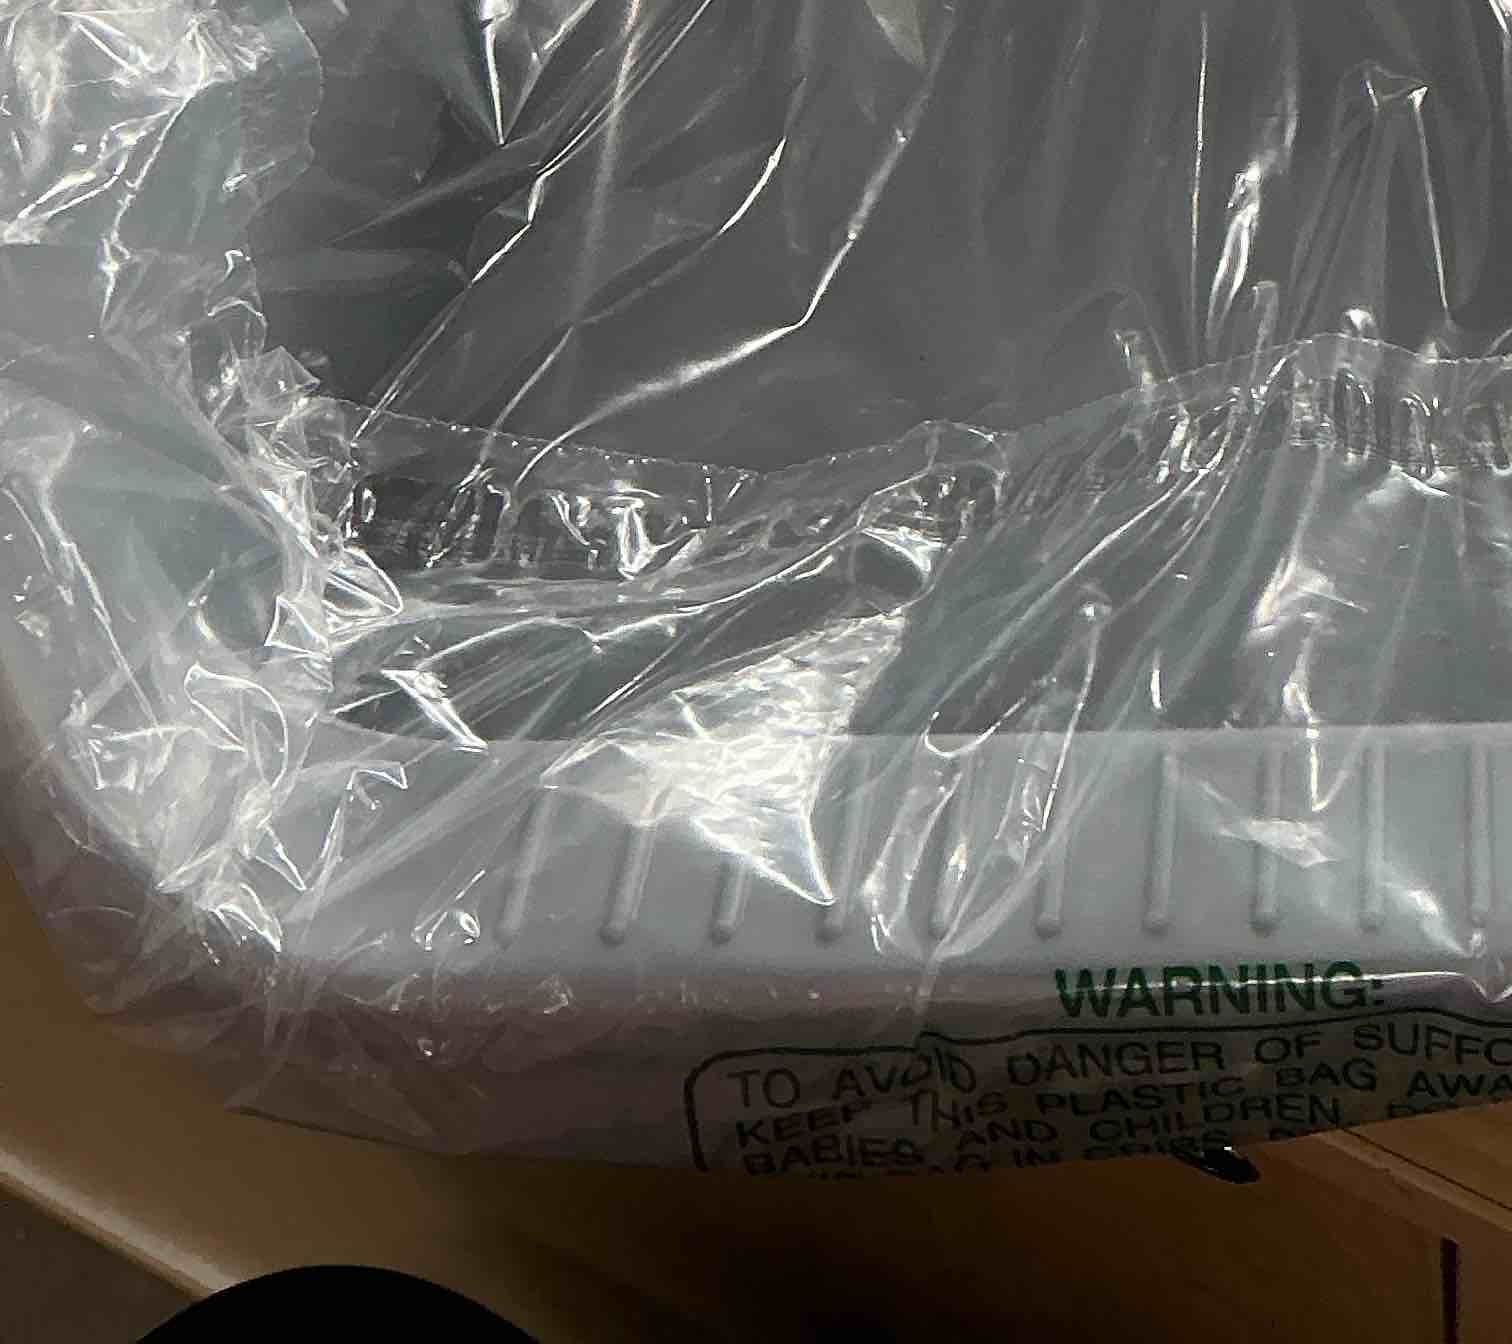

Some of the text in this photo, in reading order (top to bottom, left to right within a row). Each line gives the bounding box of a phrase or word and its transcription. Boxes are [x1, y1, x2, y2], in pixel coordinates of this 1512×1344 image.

[1055, 961, 1384, 1018] WARNING:
[727, 1068, 802, 1109] TO
[832, 1046, 977, 1102] AVOID
[1007, 1040, 1225, 1087] DANGER
[1254, 1031, 1323, 1066] OF
[735, 1100, 871, 1148] KEEP
[1036, 1076, 1247, 1118] PLASTIC
[1276, 1057, 1377, 1093] BAG
[955, 1117, 1060, 1151] AND
